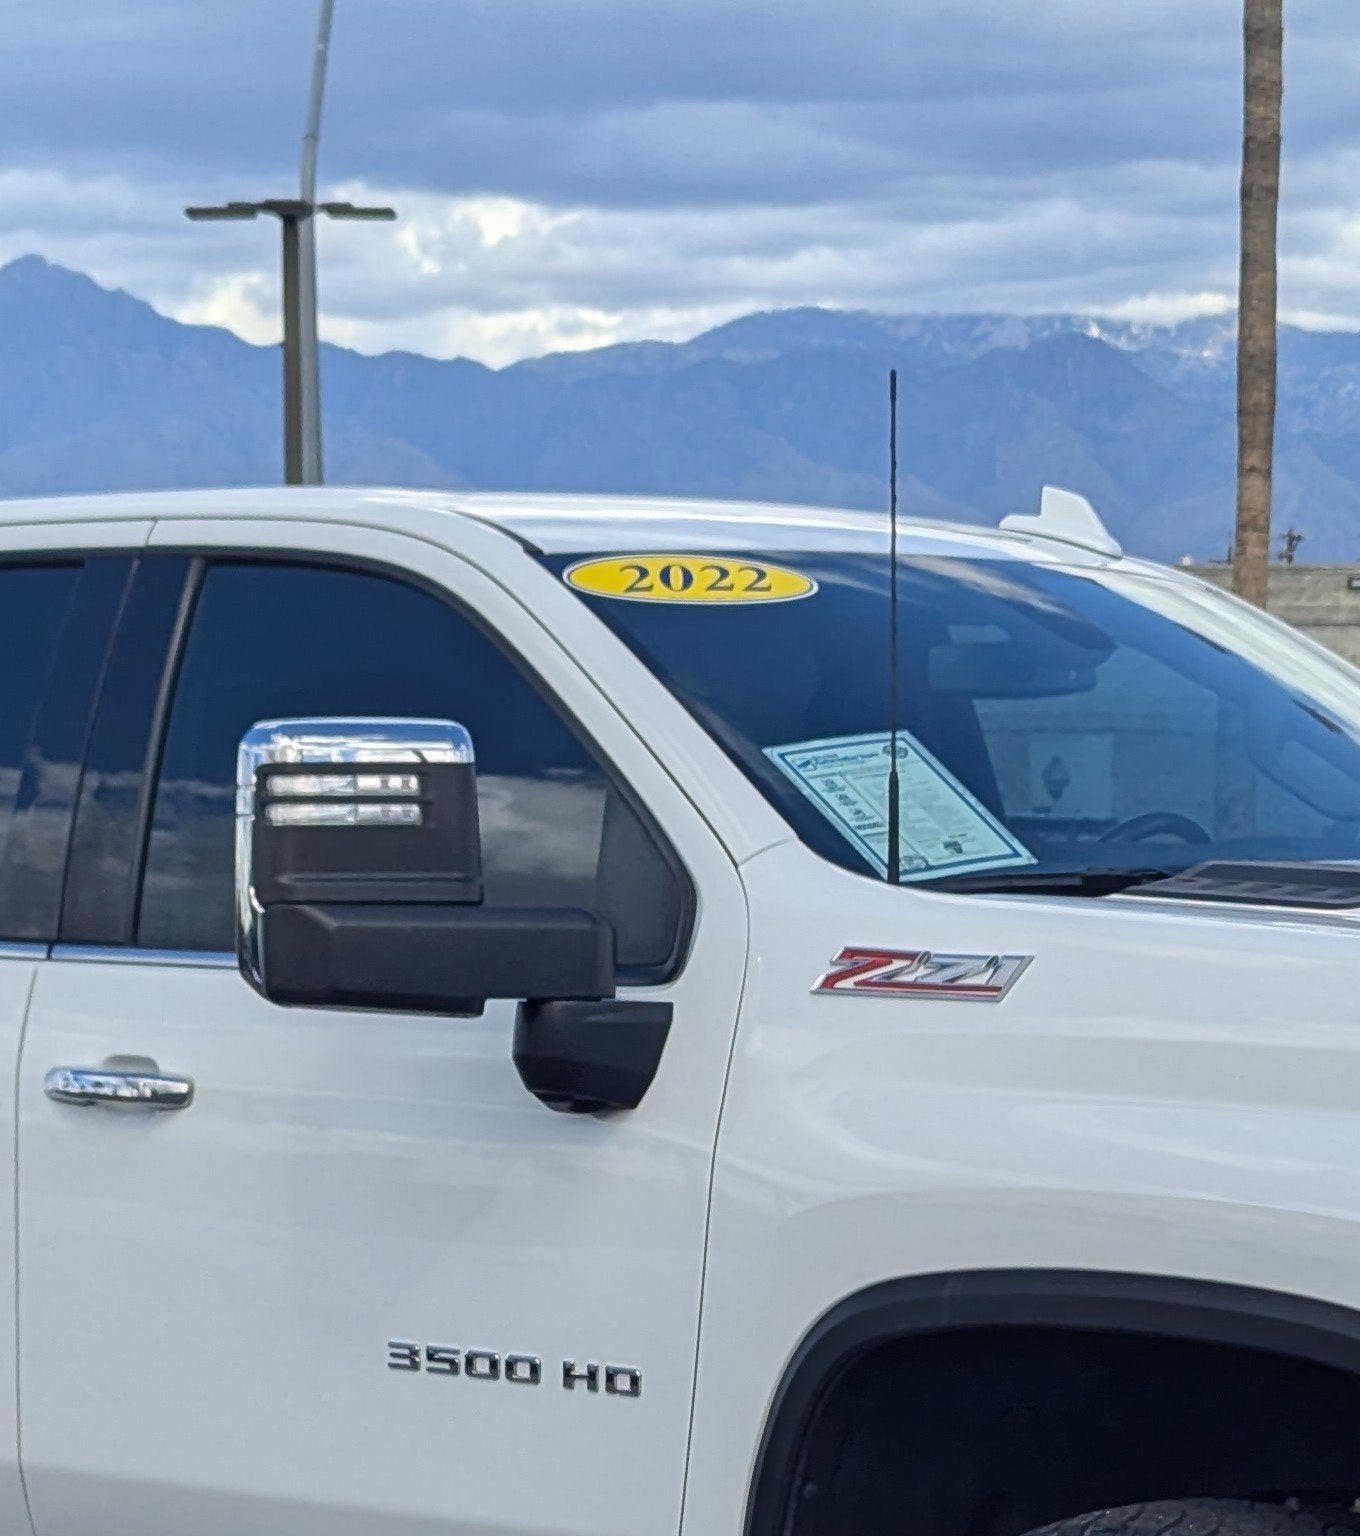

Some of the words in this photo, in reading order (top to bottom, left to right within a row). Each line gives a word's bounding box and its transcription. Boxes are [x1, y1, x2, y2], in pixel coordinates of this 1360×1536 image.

[618, 563, 772, 594] 2022
[809, 944, 1036, 1003] Z71
[387, 1338, 542, 1387] 3500
[561, 1358, 642, 1399] HD
